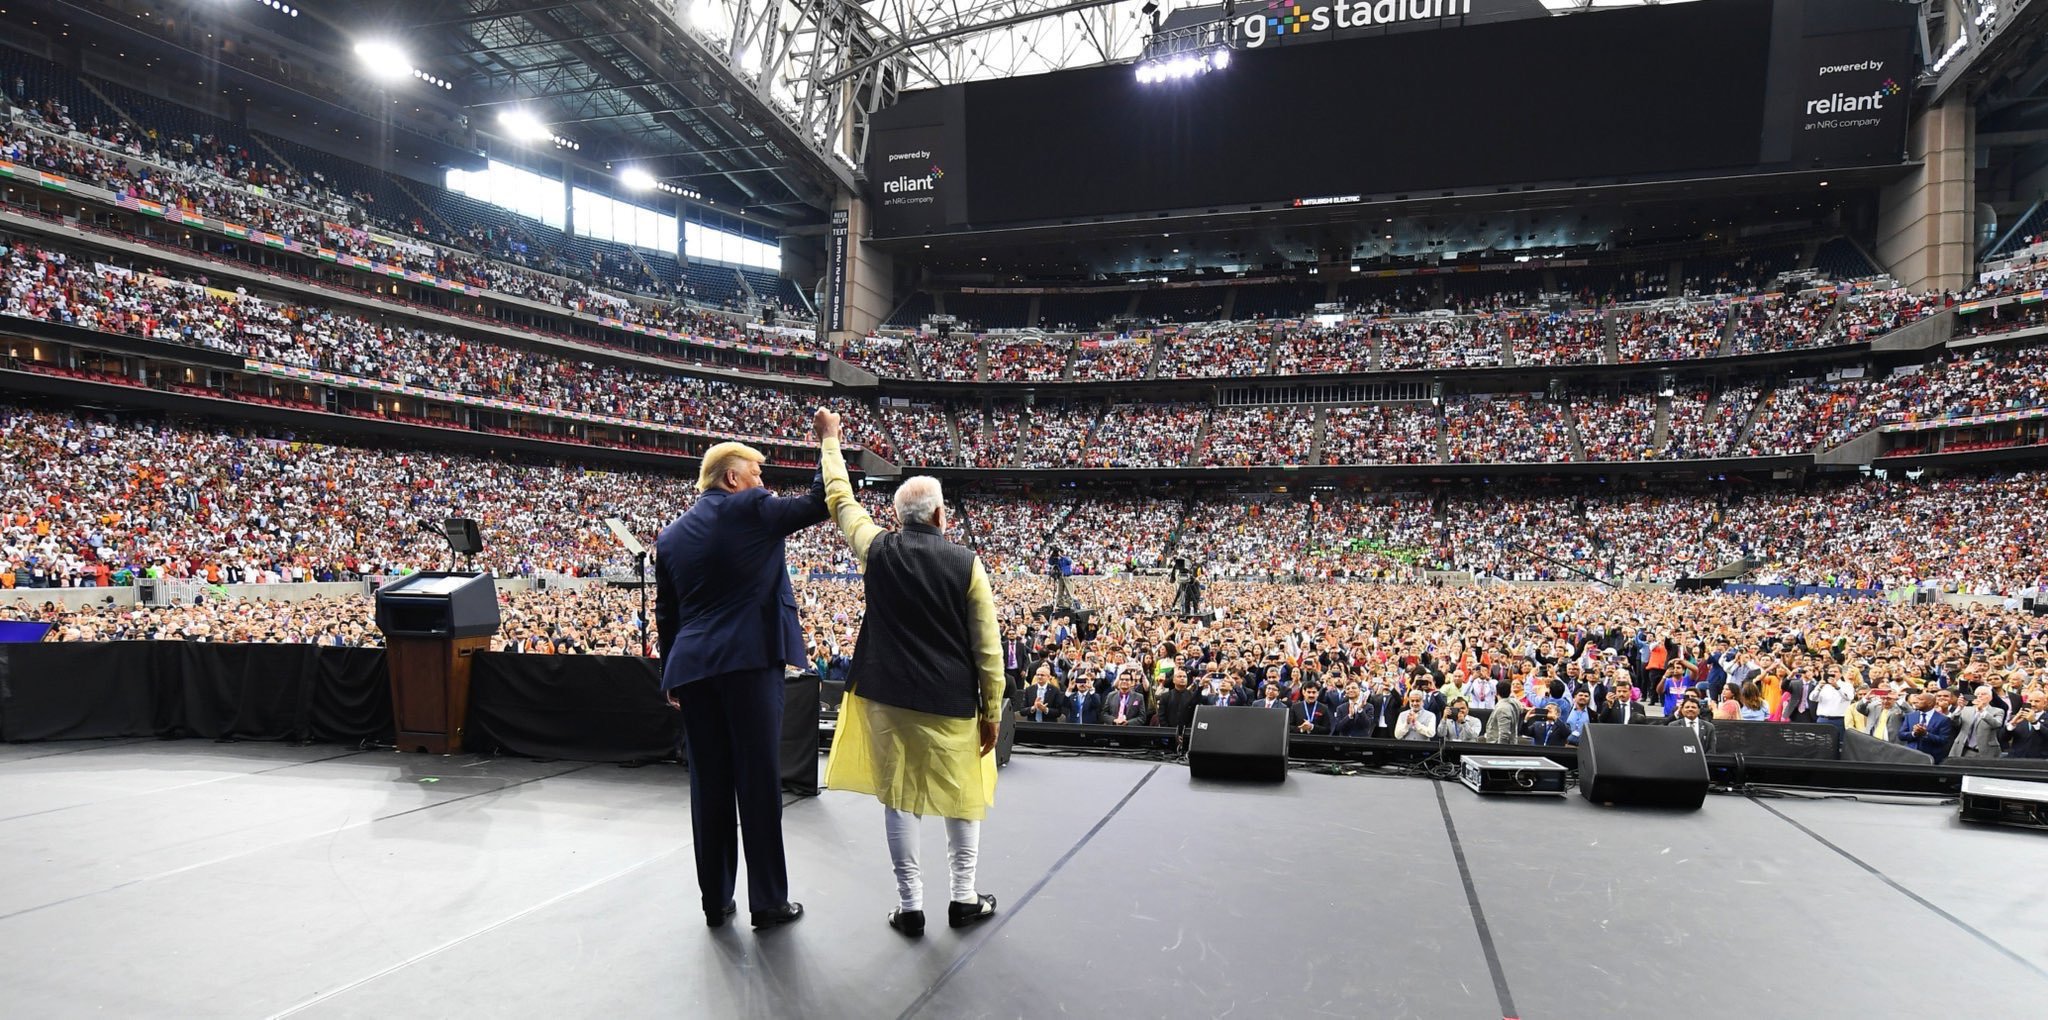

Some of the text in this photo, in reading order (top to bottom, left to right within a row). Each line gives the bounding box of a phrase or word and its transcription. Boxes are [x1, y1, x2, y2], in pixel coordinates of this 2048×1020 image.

[1311, 0, 1471, 31] stadium
[1819, 60, 1884, 76] powered by
[1806, 91, 1883, 115] reliant
[1804, 117, 1881, 131] an NRG company
[888, 150, 931, 162] powered by
[883, 175, 934, 193] reliant
[906, 196, 934, 204] company
[832, 228, 848, 236] TEXT
